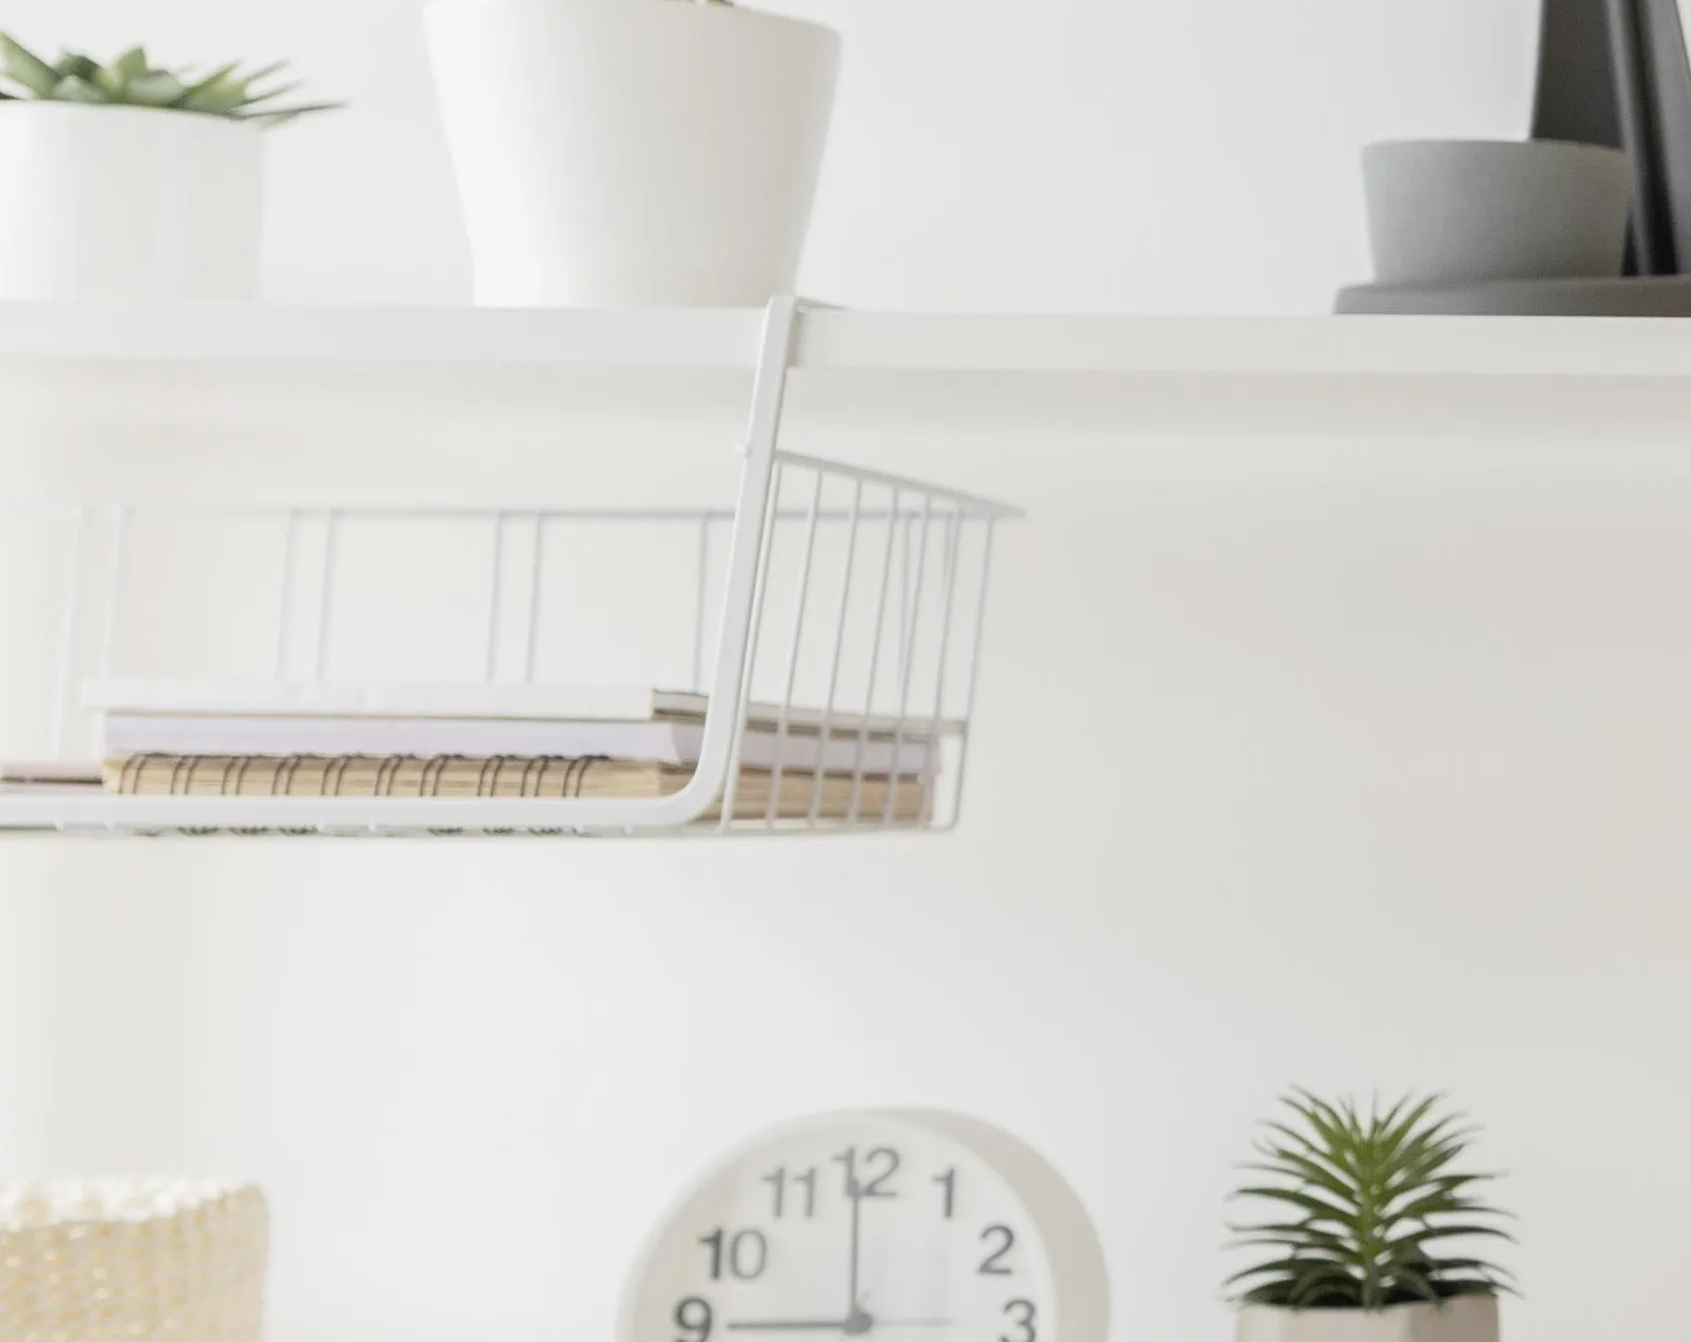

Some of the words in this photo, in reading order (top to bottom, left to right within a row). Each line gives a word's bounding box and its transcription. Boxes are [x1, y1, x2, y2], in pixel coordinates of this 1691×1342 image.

[761, 1166, 817, 1219] 11
[830, 1146, 901, 1199] 12
[932, 1167, 957, 1219] 1
[698, 1228, 768, 1281] 10
[976, 1225, 1015, 1275] 2
